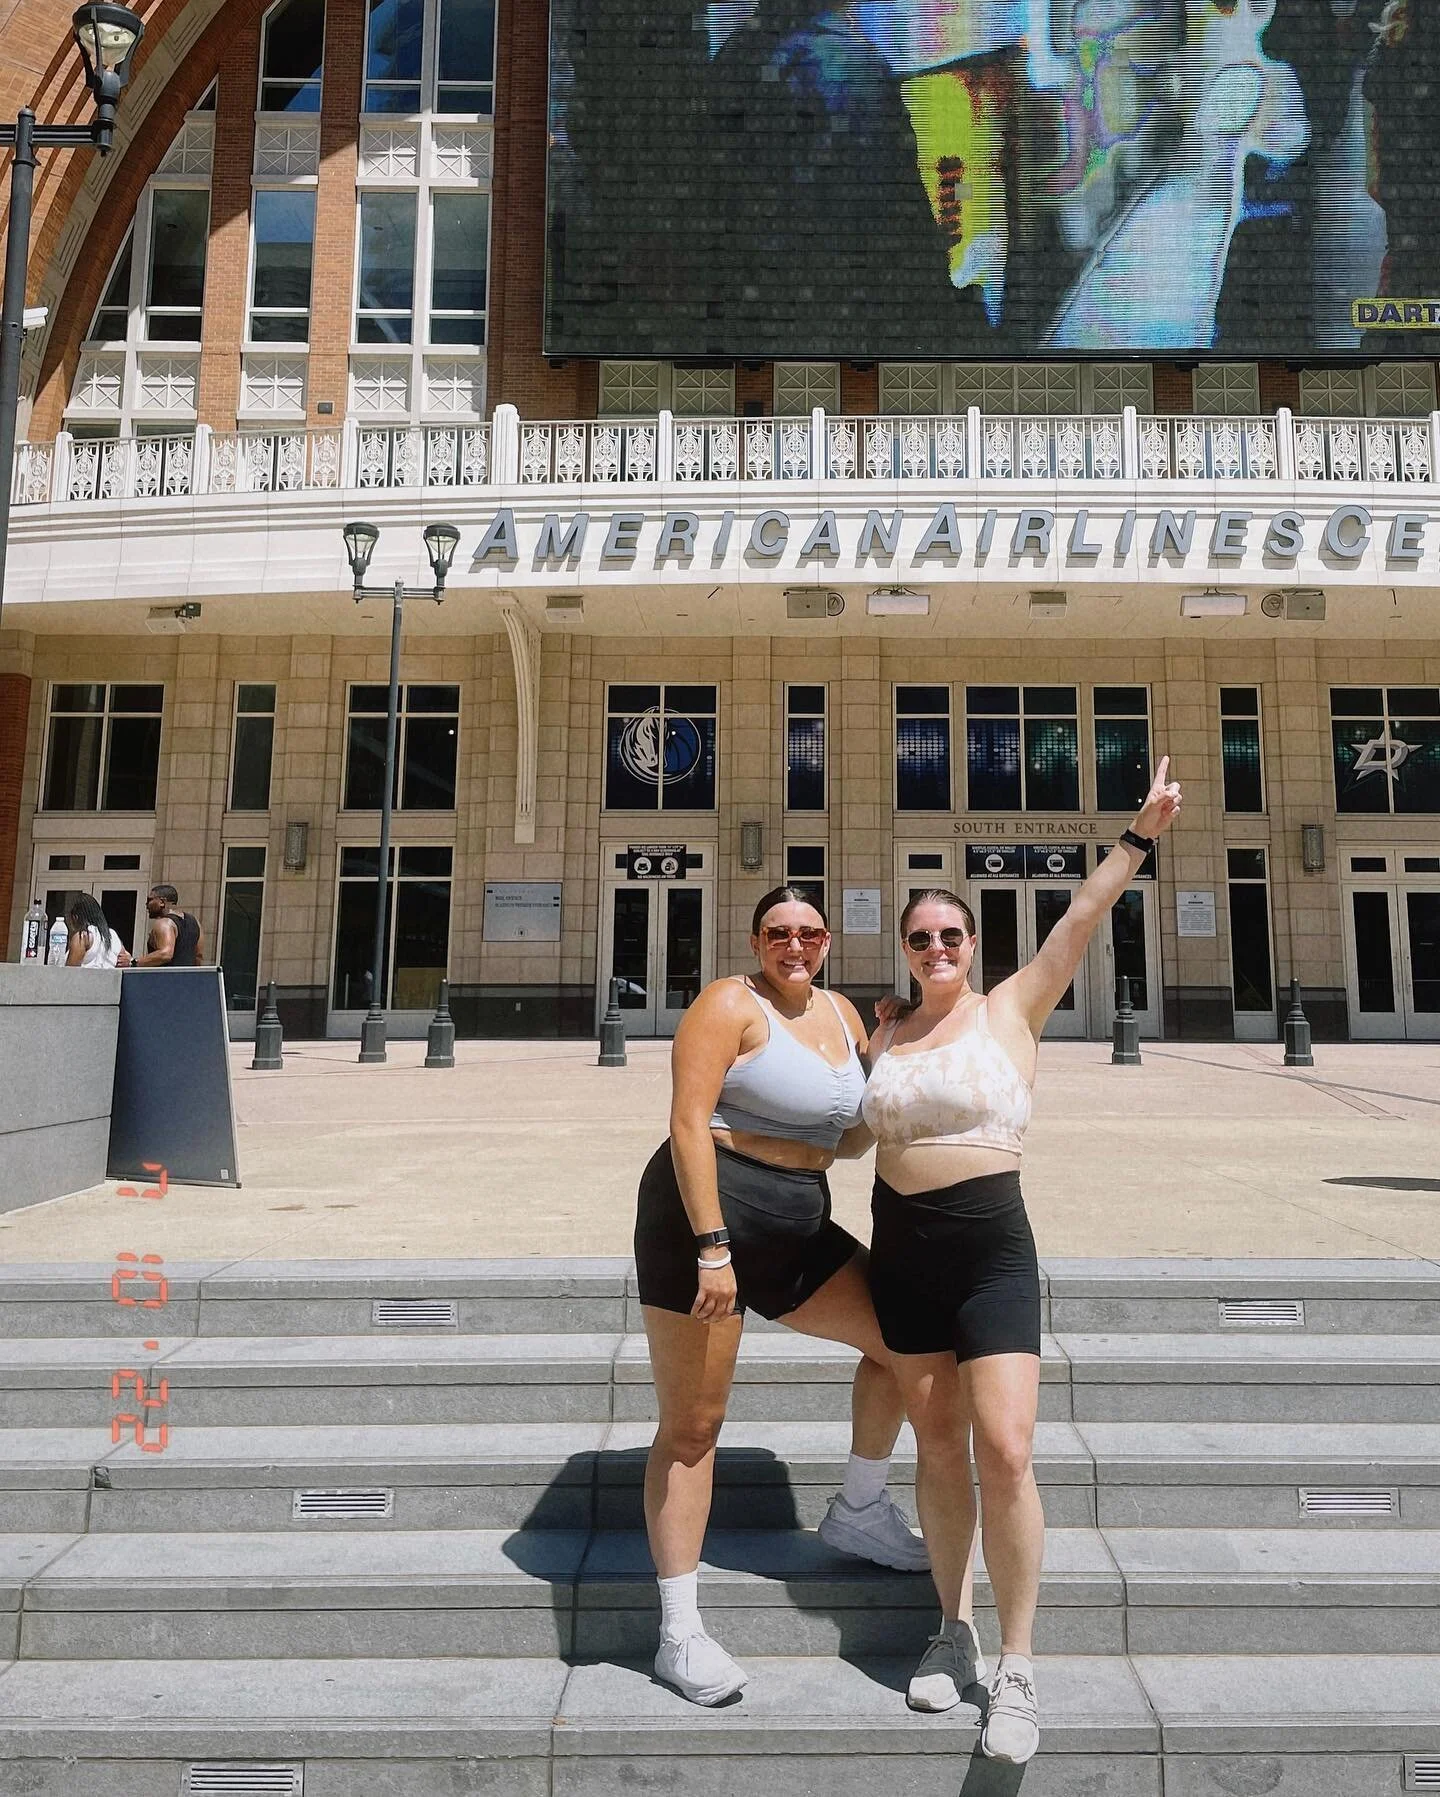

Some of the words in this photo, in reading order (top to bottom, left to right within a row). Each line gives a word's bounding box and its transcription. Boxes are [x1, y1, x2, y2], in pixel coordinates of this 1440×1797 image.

[1357, 303, 1440, 323] DART
[1323, 504, 1440, 559] CE
[953, 822, 1005, 834] SOUTH
[1015, 822, 1098, 835] ENTRANCE
